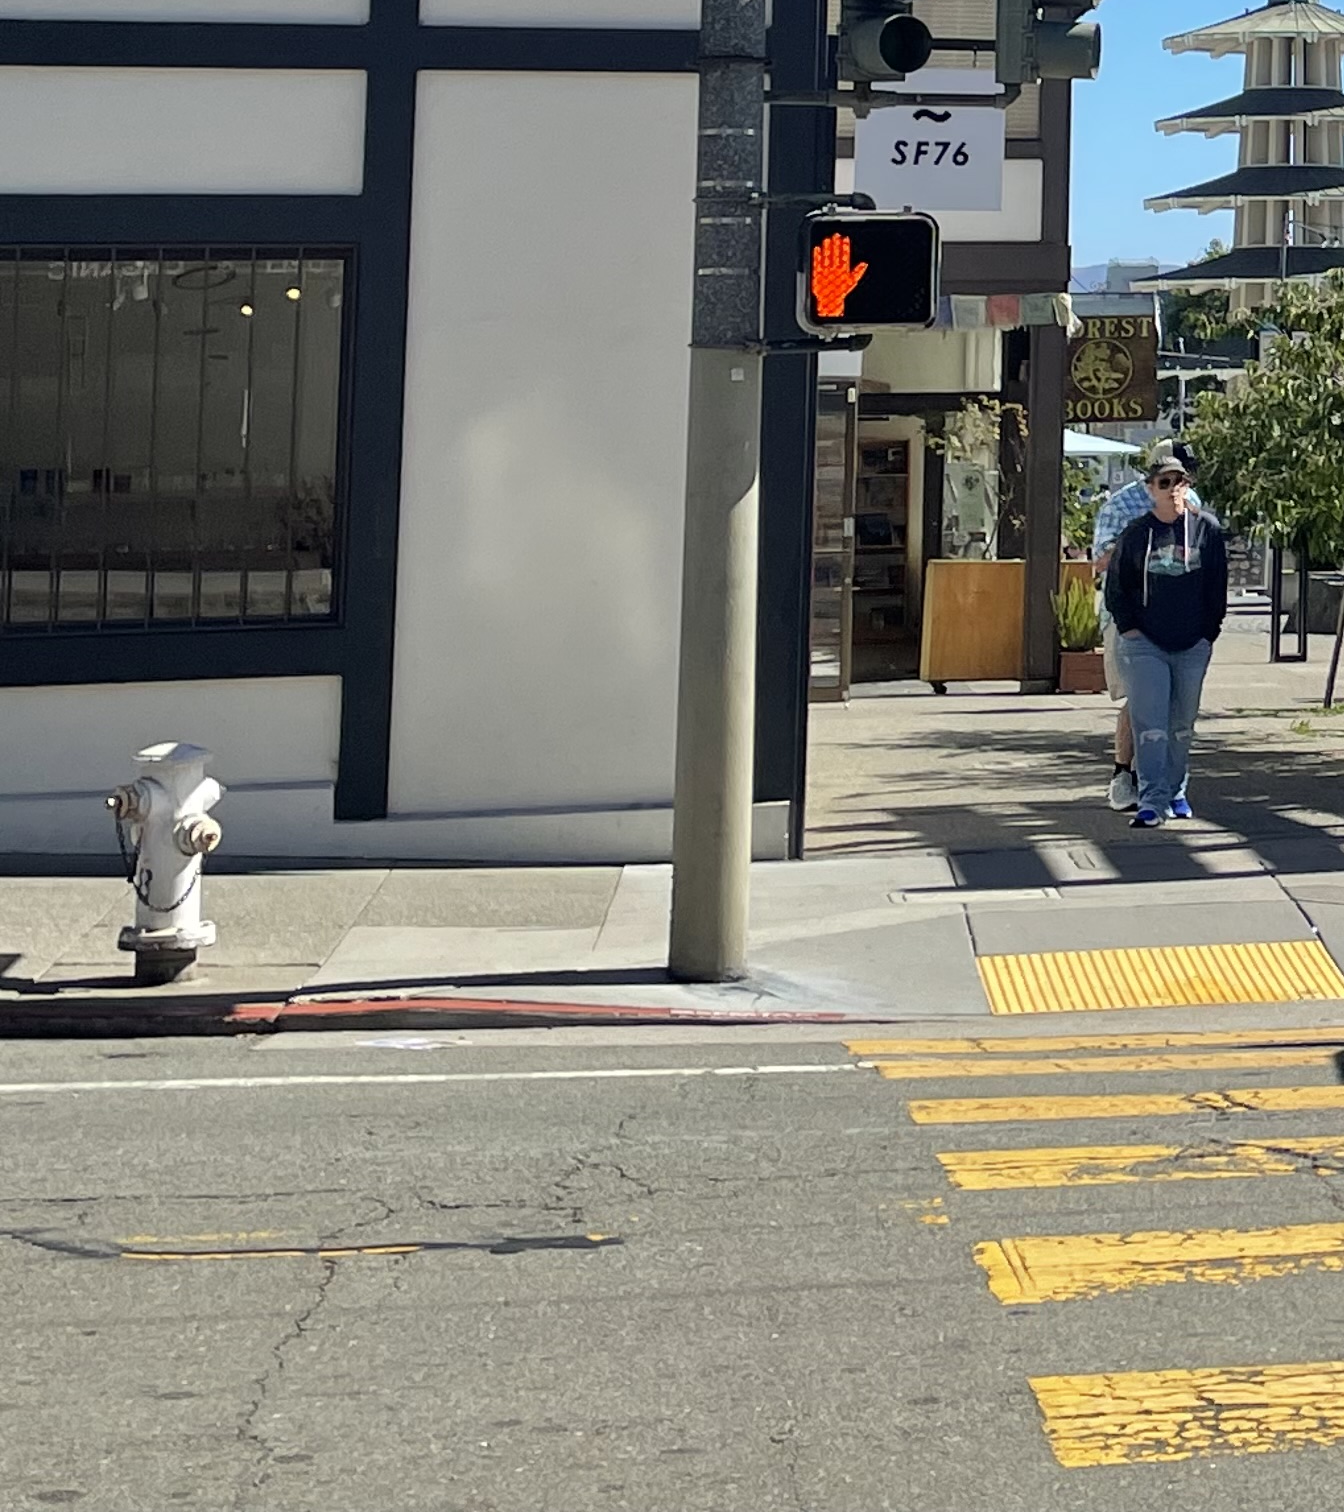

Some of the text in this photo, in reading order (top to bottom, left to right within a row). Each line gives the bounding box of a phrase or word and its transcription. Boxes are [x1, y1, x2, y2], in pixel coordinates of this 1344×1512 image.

[890, 140, 969, 166] SF76
[1068, 317, 1152, 339] OREST
[1065, 397, 1144, 420] BOOKS
